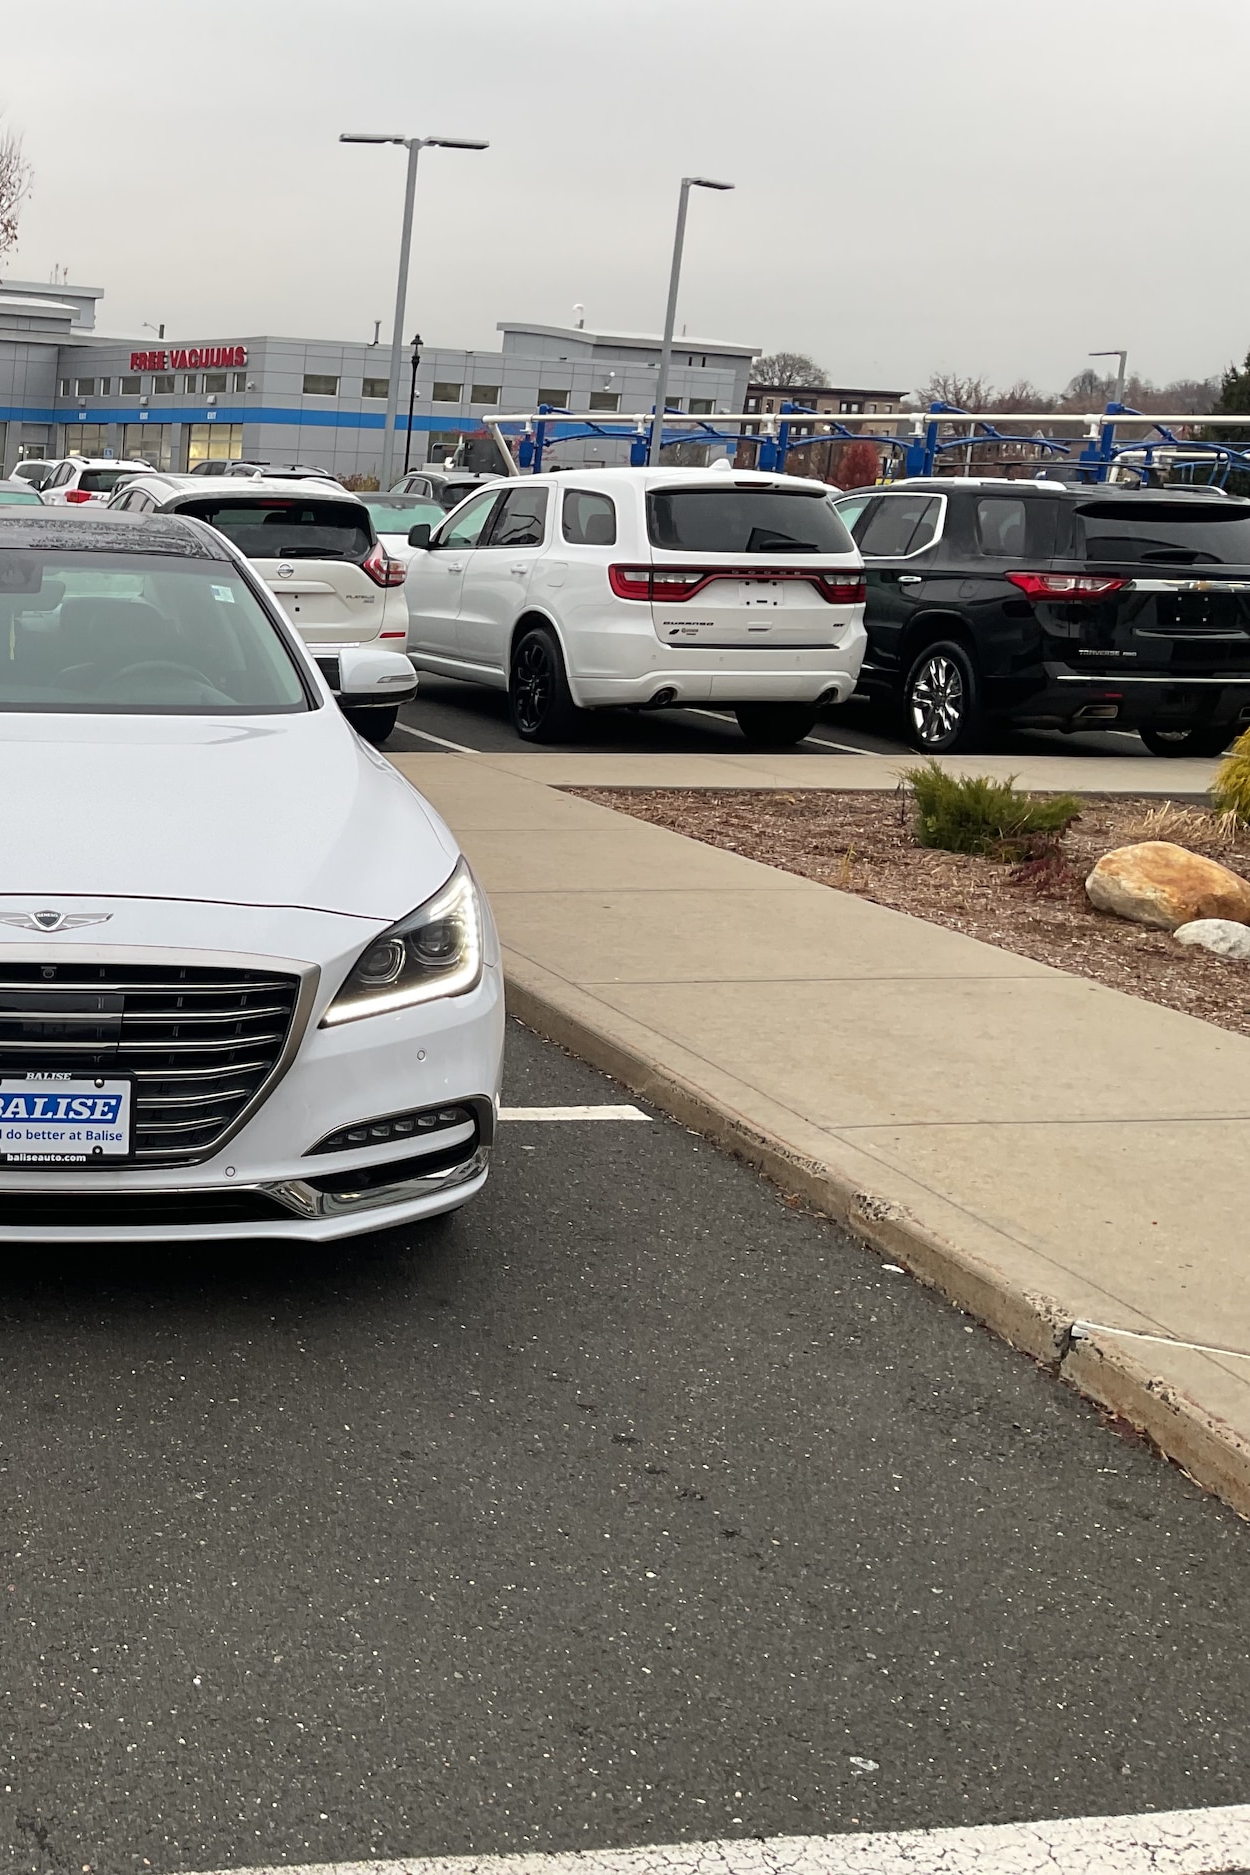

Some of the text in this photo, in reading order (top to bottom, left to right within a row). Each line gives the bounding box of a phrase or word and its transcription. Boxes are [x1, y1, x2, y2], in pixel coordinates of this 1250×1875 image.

[130, 345, 248, 371] FREE VACUUMS
[25, 1072, 72, 1081] BALISE
[6, 1129, 22, 1140] do
[26, 1129, 65, 1140] better
[69, 1131, 82, 1140] at
[86, 1130, 123, 1141] Balise
[6, 1153, 87, 1162] baliseauto.com
